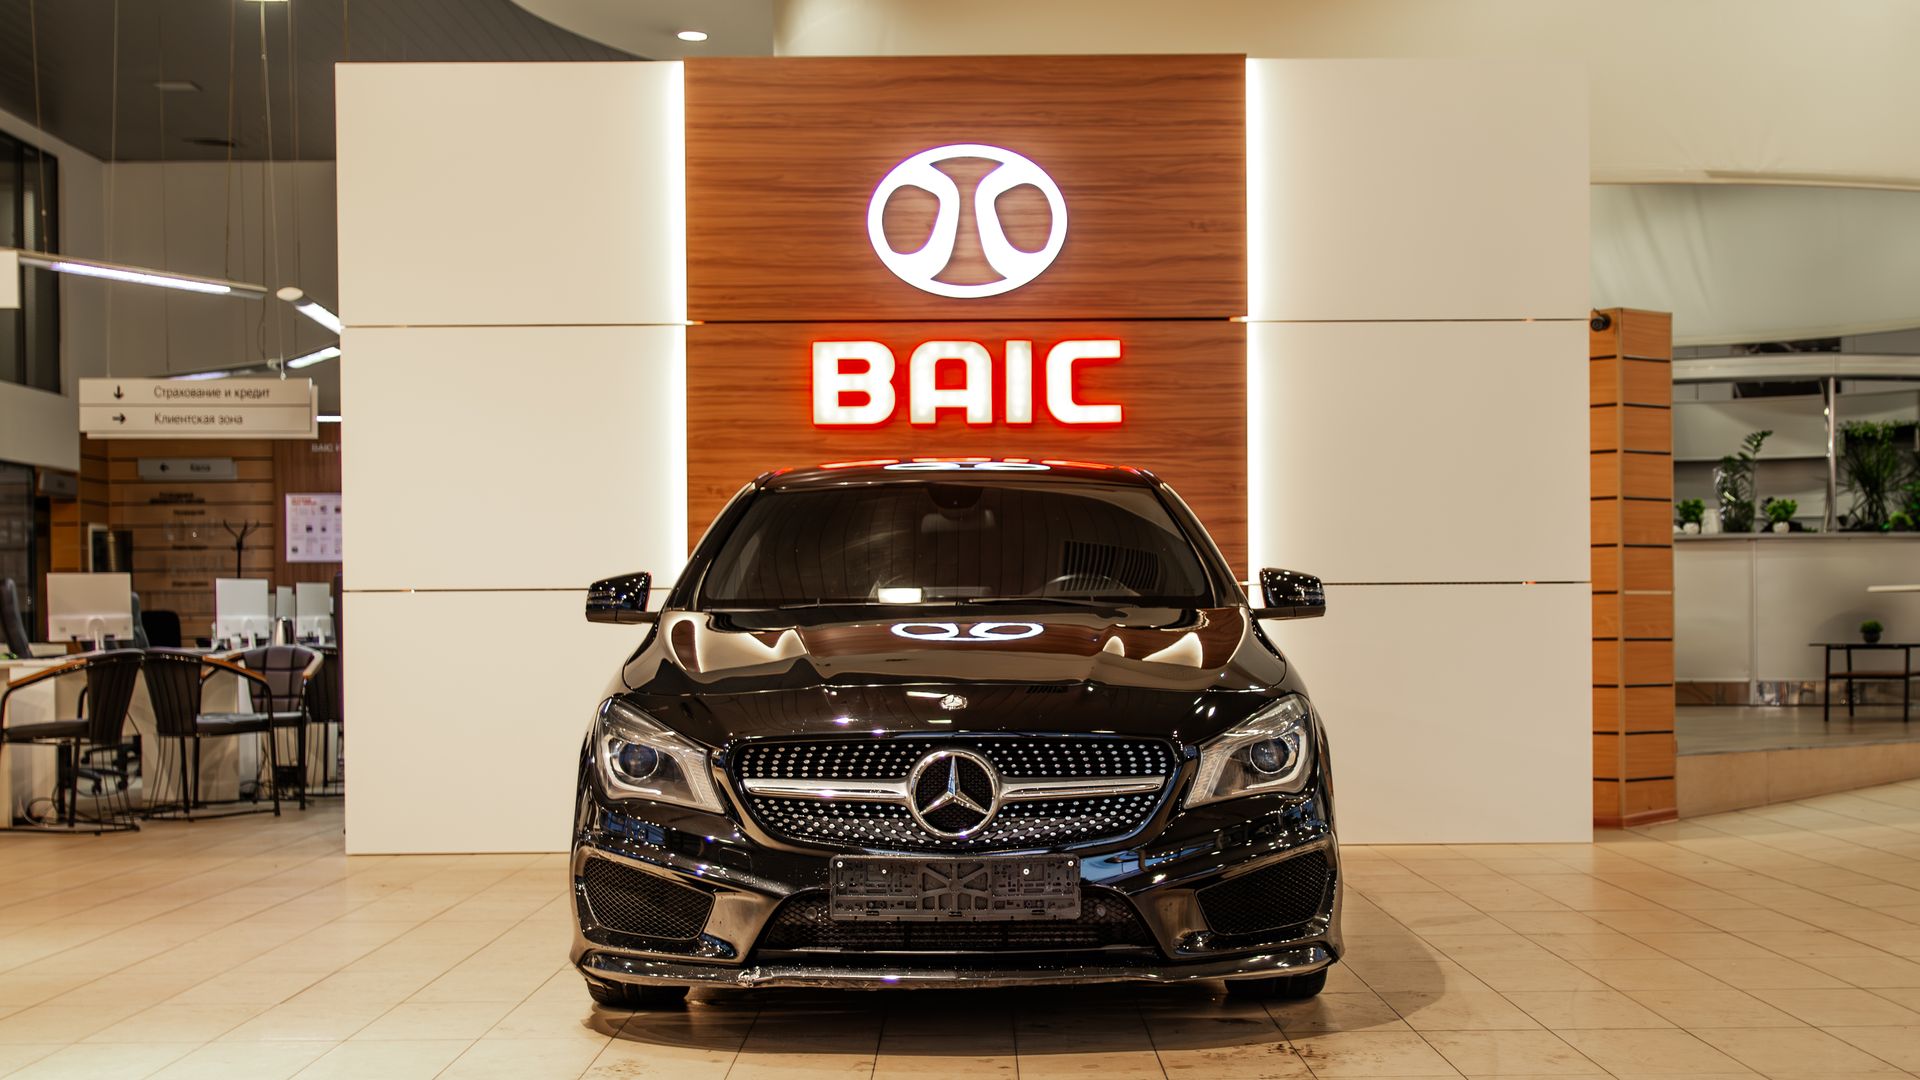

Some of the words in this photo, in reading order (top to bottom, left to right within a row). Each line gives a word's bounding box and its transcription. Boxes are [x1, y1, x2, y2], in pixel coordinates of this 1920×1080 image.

[812, 340, 1122, 424] BAIC
[154, 385, 221, 399] Страхование
[225, 388, 231, 397] и
[234, 388, 270, 399] кредит
[154, 412, 215, 424] Клиентская
[218, 415, 243, 424] зона
